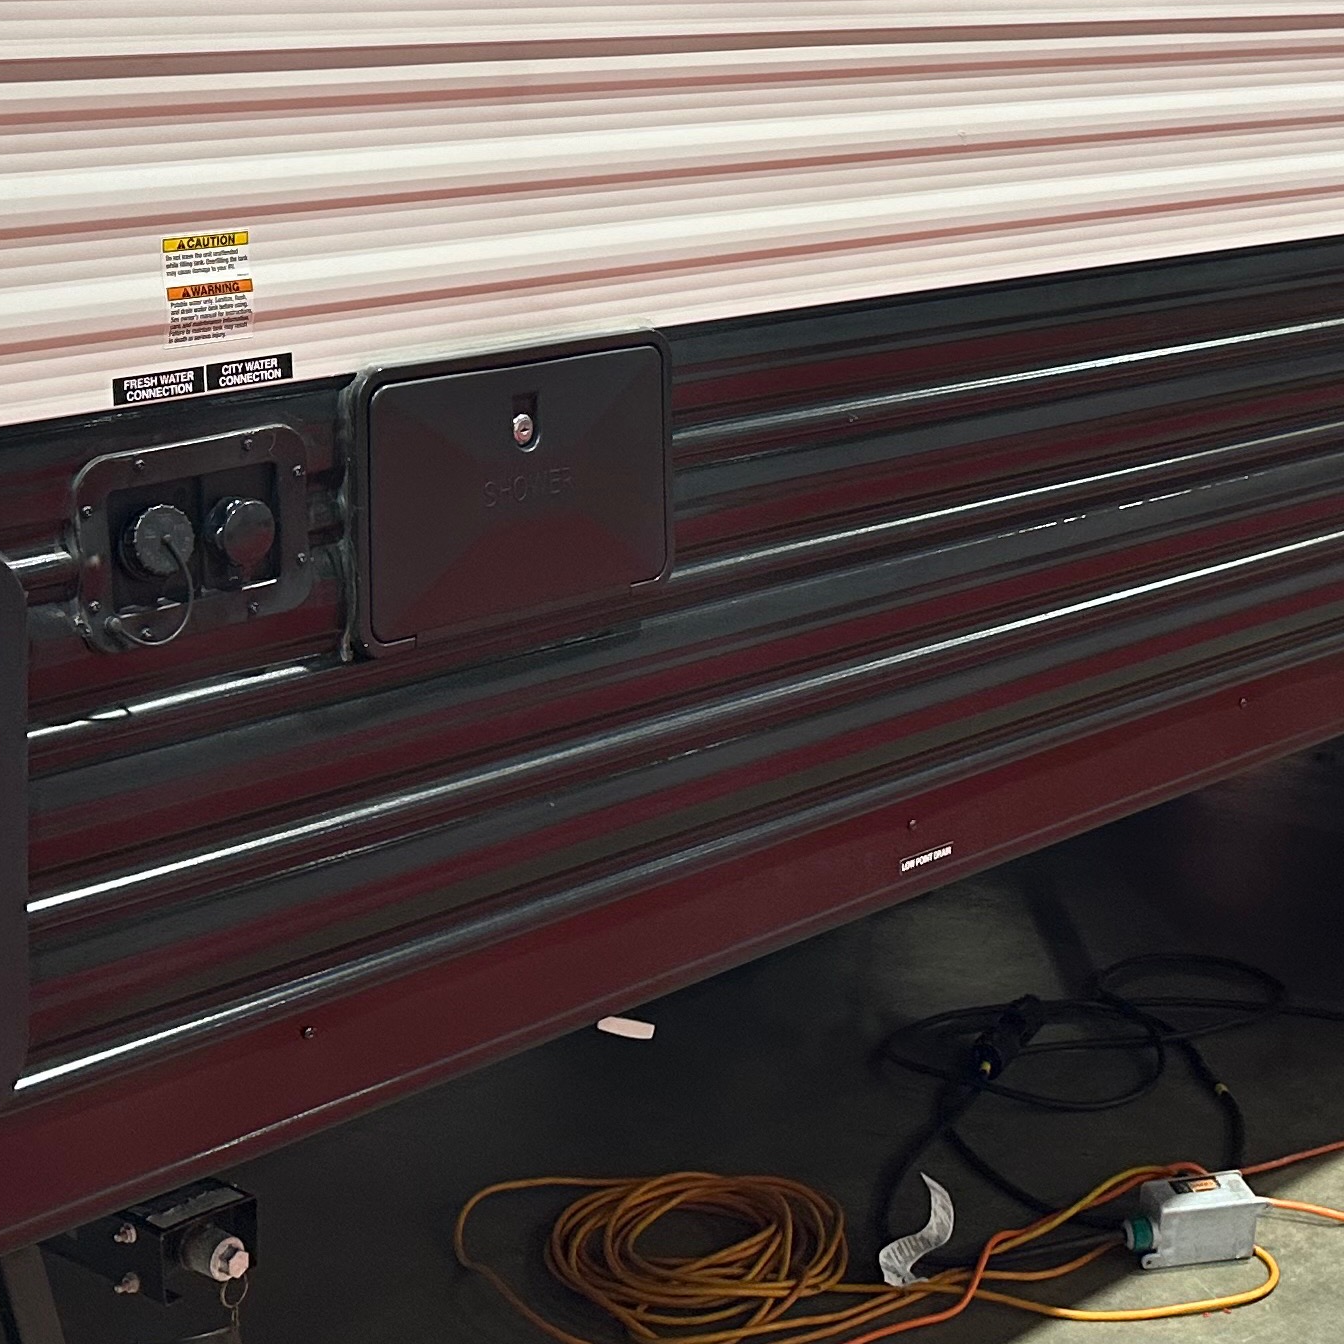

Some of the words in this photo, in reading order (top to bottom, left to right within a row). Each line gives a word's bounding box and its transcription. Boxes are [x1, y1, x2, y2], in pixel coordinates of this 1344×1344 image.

[186, 233, 235, 249] CAUTION
[190, 282, 240, 296] WARNING
[221, 362, 244, 376] CITY
[244, 357, 278, 372] WATER
[123, 375, 158, 391] FRESH
[159, 370, 195, 385] WATER
[218, 367, 282, 387] CONNECTION
[126, 382, 193, 402] CONNECTION
[901, 858, 916, 872] LOW
[933, 846, 952, 861] DRAIN
